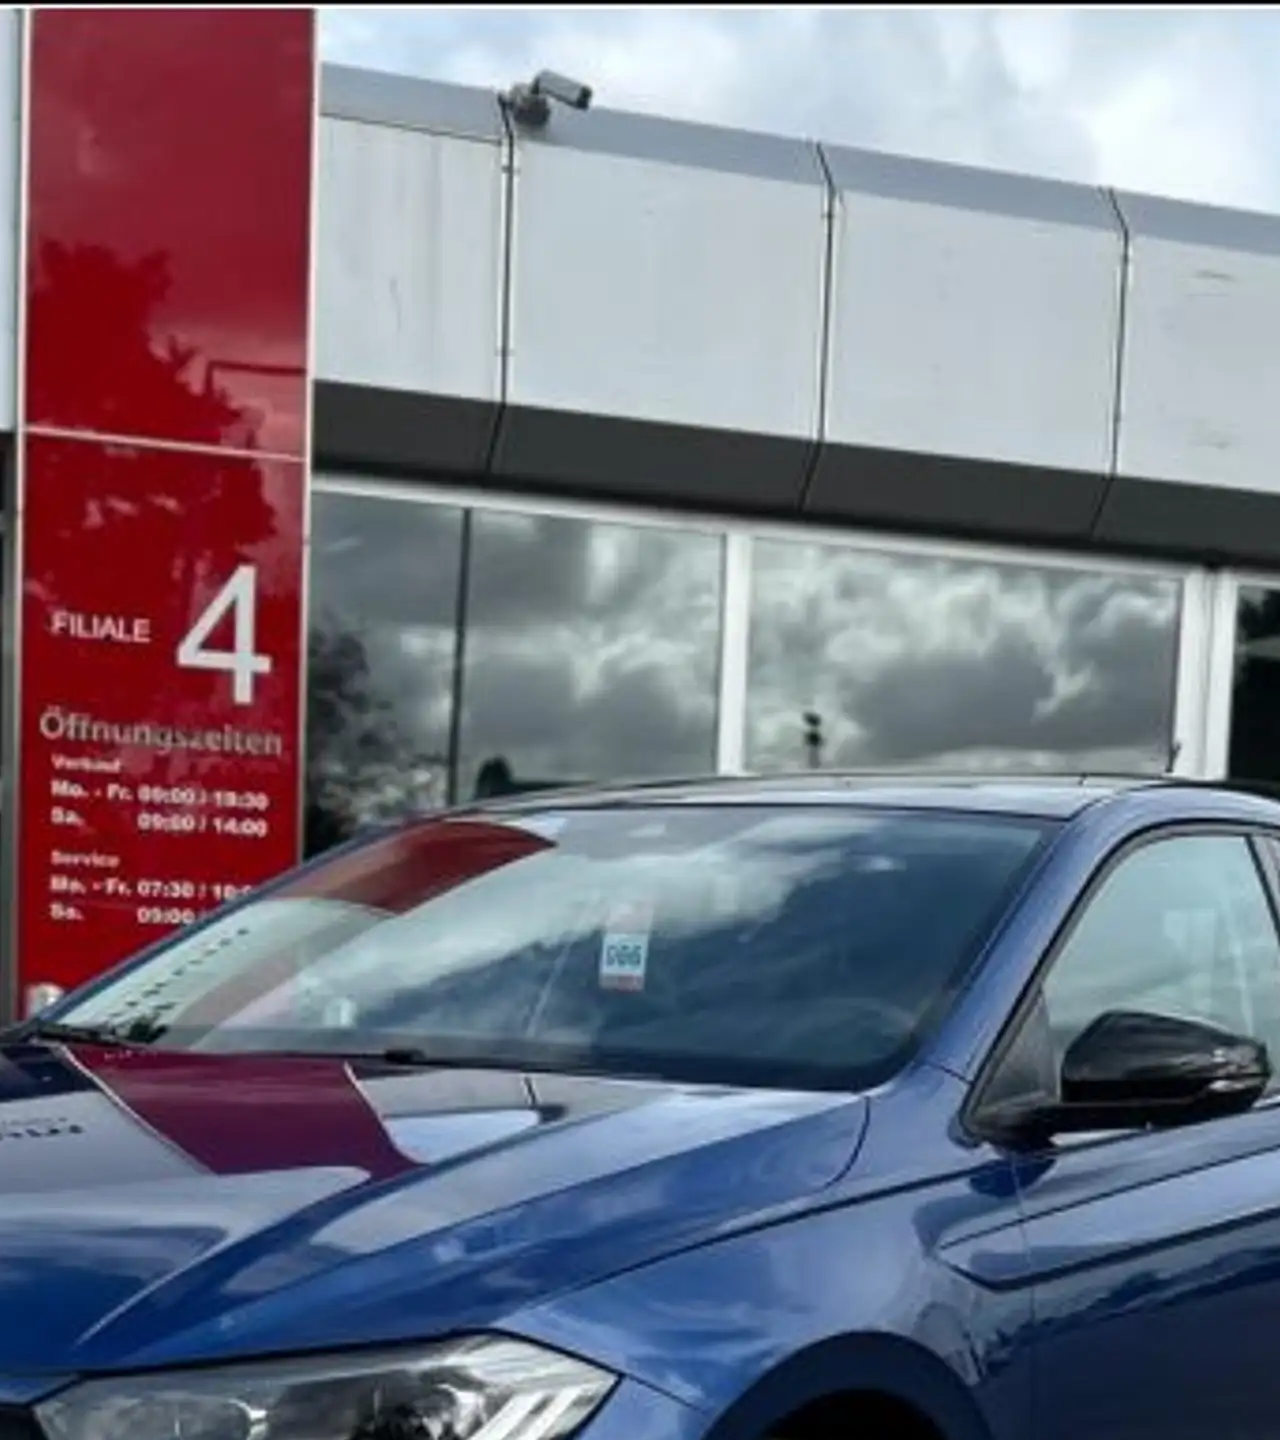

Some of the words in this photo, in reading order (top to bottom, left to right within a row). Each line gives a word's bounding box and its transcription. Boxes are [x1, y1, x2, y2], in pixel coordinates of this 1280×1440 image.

[51, 611, 151, 643] FILIALE
[176, 564, 273, 705] 4
[39, 705, 283, 757] Öffnungszeiten
[50, 778, 89, 799] Mo.
[106, 783, 134, 801] Fr.
[50, 805, 85, 826] Sa.
[49, 849, 121, 869] Service
[105, 876, 133, 897] Fr.
[136, 878, 196, 899] 07:30
